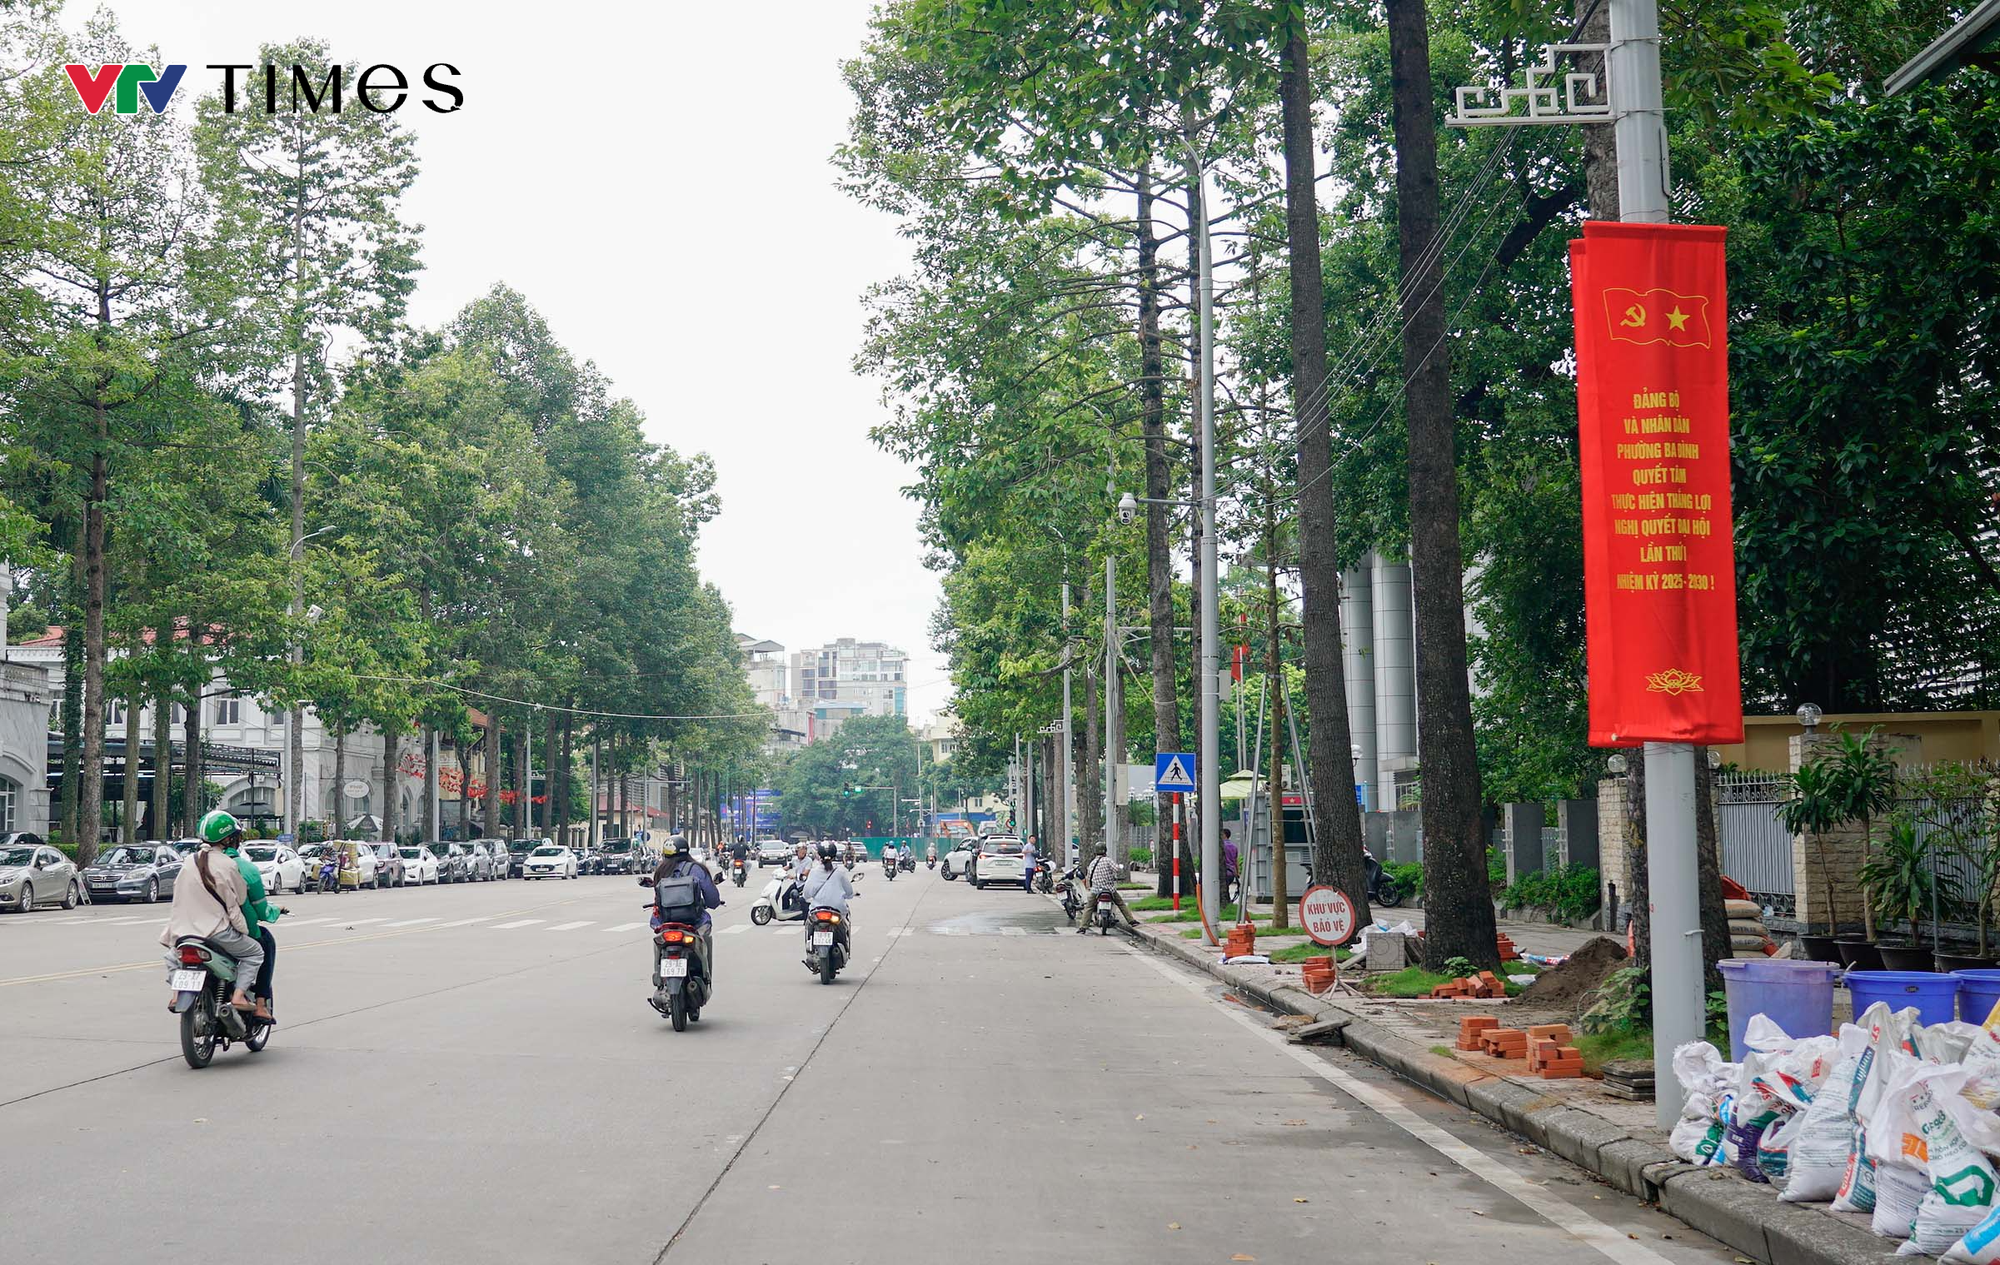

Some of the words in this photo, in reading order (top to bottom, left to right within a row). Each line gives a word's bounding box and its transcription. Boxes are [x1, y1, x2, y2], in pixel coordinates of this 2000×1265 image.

[1633, 387, 1666, 409] ĐẢNG
[1669, 390, 1680, 411] BỘ
[1624, 416, 1639, 434] VÀ
[1641, 414, 1671, 434] NHÂN
[1617, 440, 1662, 459] PHƯỜNG
[1664, 442, 1677, 458] BA
[1633, 463, 1668, 486] QUYẾT
[1611, 493, 1636, 513] THỰC
[1639, 491, 1665, 513] HIỆN
[1667, 488, 1693, 509] THẮNG
[1695, 493, 1712, 514] LỢI
[1615, 519, 1639, 538] NGHỊ
[1641, 513, 1676, 537] QUYẾT
[1692, 517, 1711, 539] HỘI
[1640, 541, 1663, 563] LẦN
[1617, 571, 1643, 593] NHIỆM
[1646, 571, 1659, 590] KỲ
[219, 825, 233, 835] Grab
[1327, 900, 1346, 915] VỰC
[1313, 917, 1332, 933] BẢO
[1333, 917, 1345, 933] VỆ
